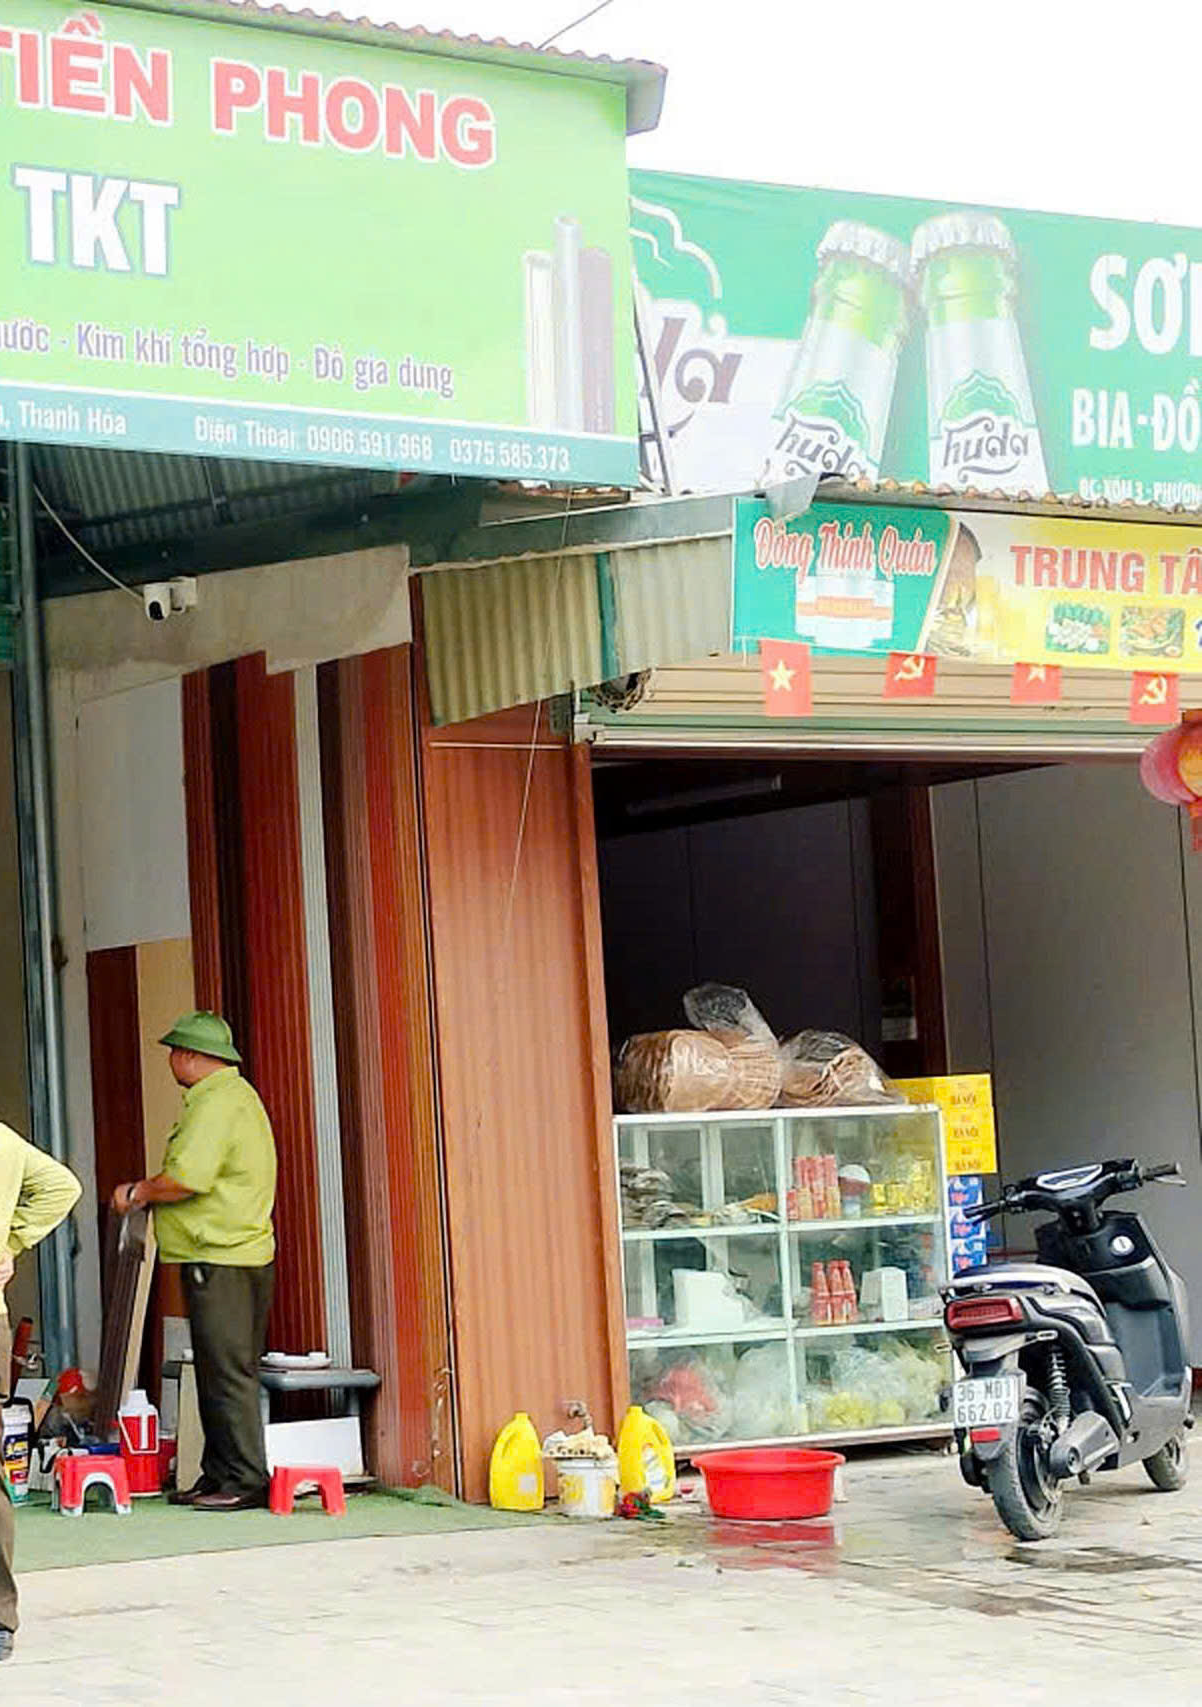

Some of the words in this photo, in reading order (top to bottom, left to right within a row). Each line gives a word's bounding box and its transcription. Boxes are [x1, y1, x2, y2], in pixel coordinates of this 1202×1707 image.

[211, 60, 496, 167] PHONG
[14, 163, 180, 276] TKT
[77, 323, 125, 360] Kim
[182, 328, 237, 378] tổng
[355, 357, 389, 391] gia
[399, 357, 454, 399] dụng
[17, 400, 81, 433] Thanh
[306, 425, 433, 462] 0906.591.968
[449, 438, 571, 473] 0375.585.373
[1009, 545, 1145, 593] TRUNG
